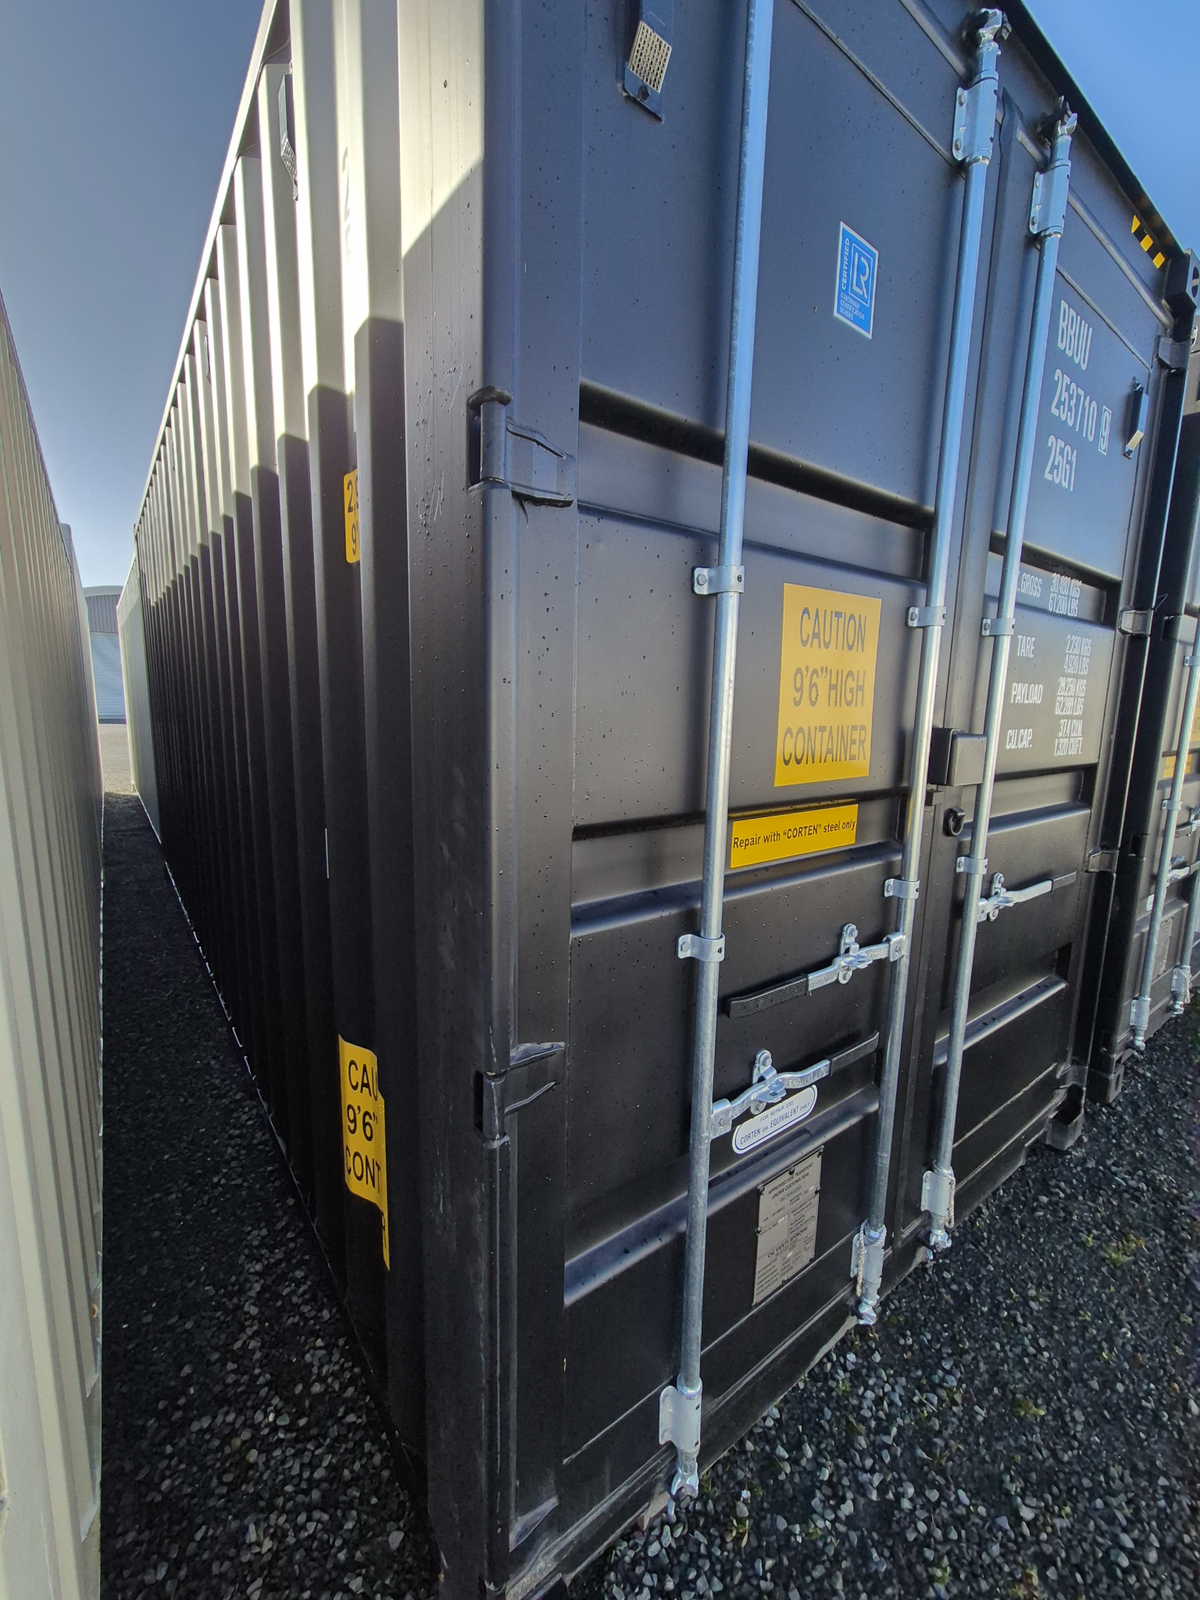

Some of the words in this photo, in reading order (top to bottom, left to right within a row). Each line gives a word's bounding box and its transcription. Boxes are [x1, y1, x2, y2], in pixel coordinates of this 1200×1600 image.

[842, 238, 850, 290] CERTIFIED
[853, 252, 870, 299] LR
[1057, 299, 1092, 371] BBUU
[1050, 368, 1098, 442] 253710
[1099, 408, 1111, 453] 9
[1044, 434, 1078, 491] 25G1
[1067, 598, 1079, 617] LBS
[799, 606, 867, 653] CAUTION
[1016, 634, 1036, 658] TARE
[1078, 656, 1090, 676] LBS
[1010, 682, 1044, 704] PAYLOAD
[1073, 697, 1085, 716] LBS
[782, 724, 867, 767] CONTAINER
[733, 833, 761, 850] Repair
[763, 830, 781, 844] with
[823, 820, 840, 833] steel
[842, 819, 856, 831] only
[740, 1127, 761, 1145] CORTEN
[770, 1106, 799, 1128] EQUIVALENT
